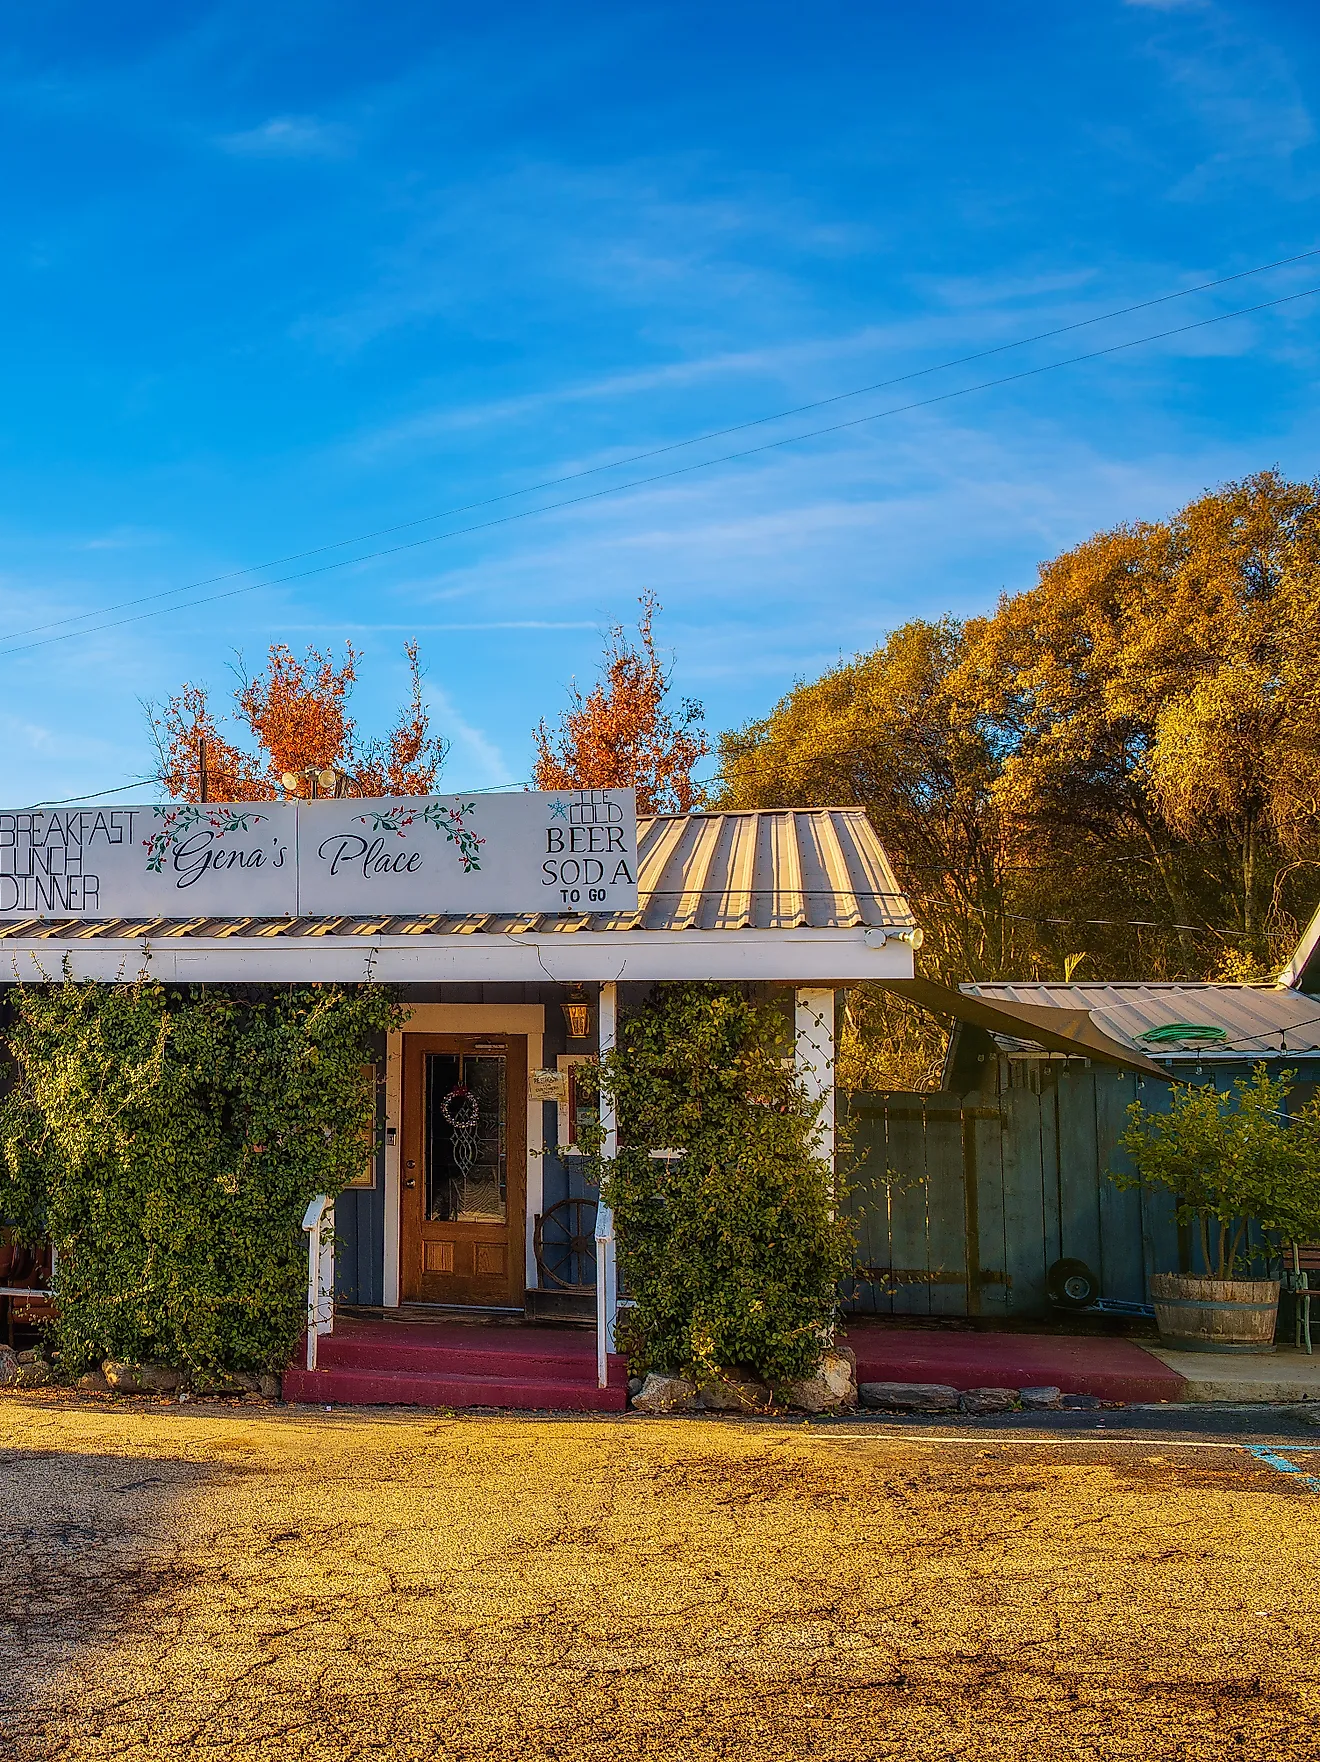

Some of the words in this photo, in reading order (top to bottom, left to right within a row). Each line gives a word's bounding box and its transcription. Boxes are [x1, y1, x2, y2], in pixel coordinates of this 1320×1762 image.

[573, 788, 613, 804] ICE
[569, 803, 624, 824] COLD
[545, 826, 629, 854] BEER
[173, 830, 288, 889] Gena's
[318, 833, 424, 879] Place
[541, 858, 636, 886] SODA
[560, 889, 581, 903] TO
[588, 888, 607, 902] GO
